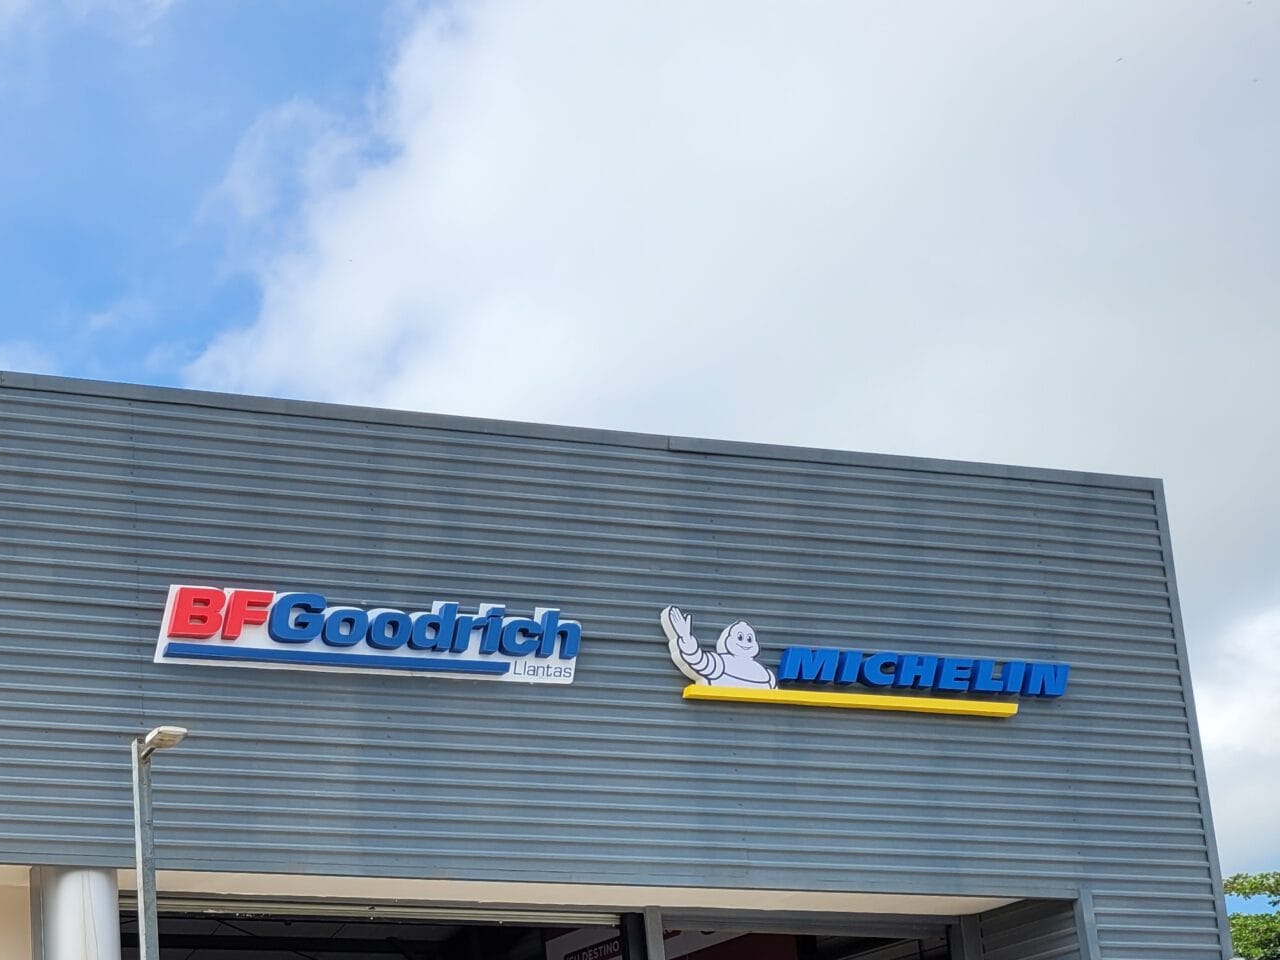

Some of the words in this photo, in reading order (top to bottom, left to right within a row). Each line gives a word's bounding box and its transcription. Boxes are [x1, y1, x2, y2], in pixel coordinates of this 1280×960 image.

[166, 586, 582, 660] BFGoodrich
[513, 660, 572, 679] Llantas
[778, 647, 1071, 698] MICHELIN
